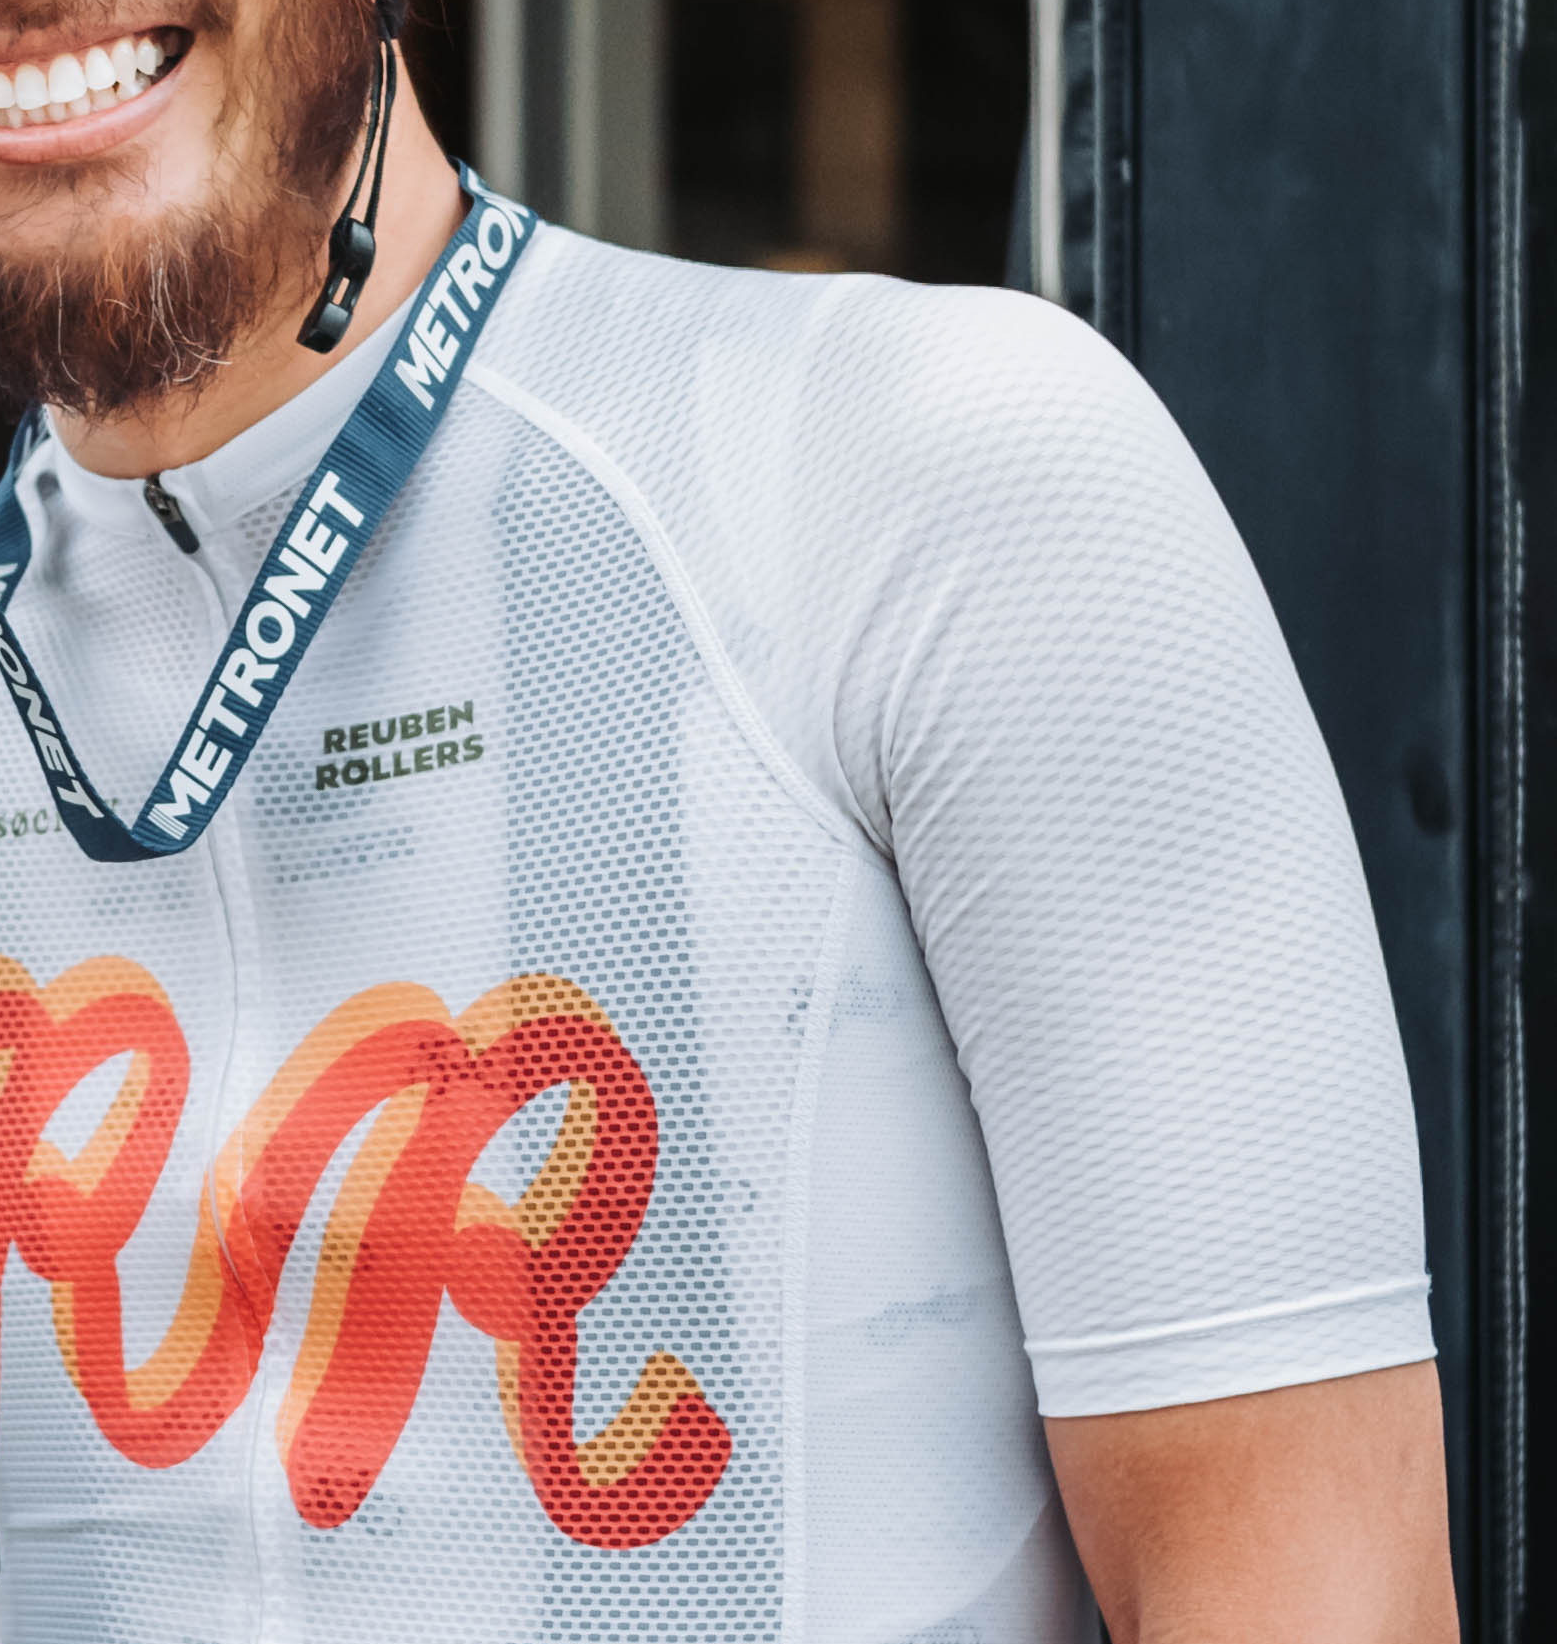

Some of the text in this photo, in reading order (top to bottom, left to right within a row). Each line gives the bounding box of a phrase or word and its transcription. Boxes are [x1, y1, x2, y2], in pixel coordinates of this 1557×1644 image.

[145, 470, 365, 841] METRONET
[322, 699, 475, 755] REUBEN
[314, 733, 485, 791] ROLLERS
